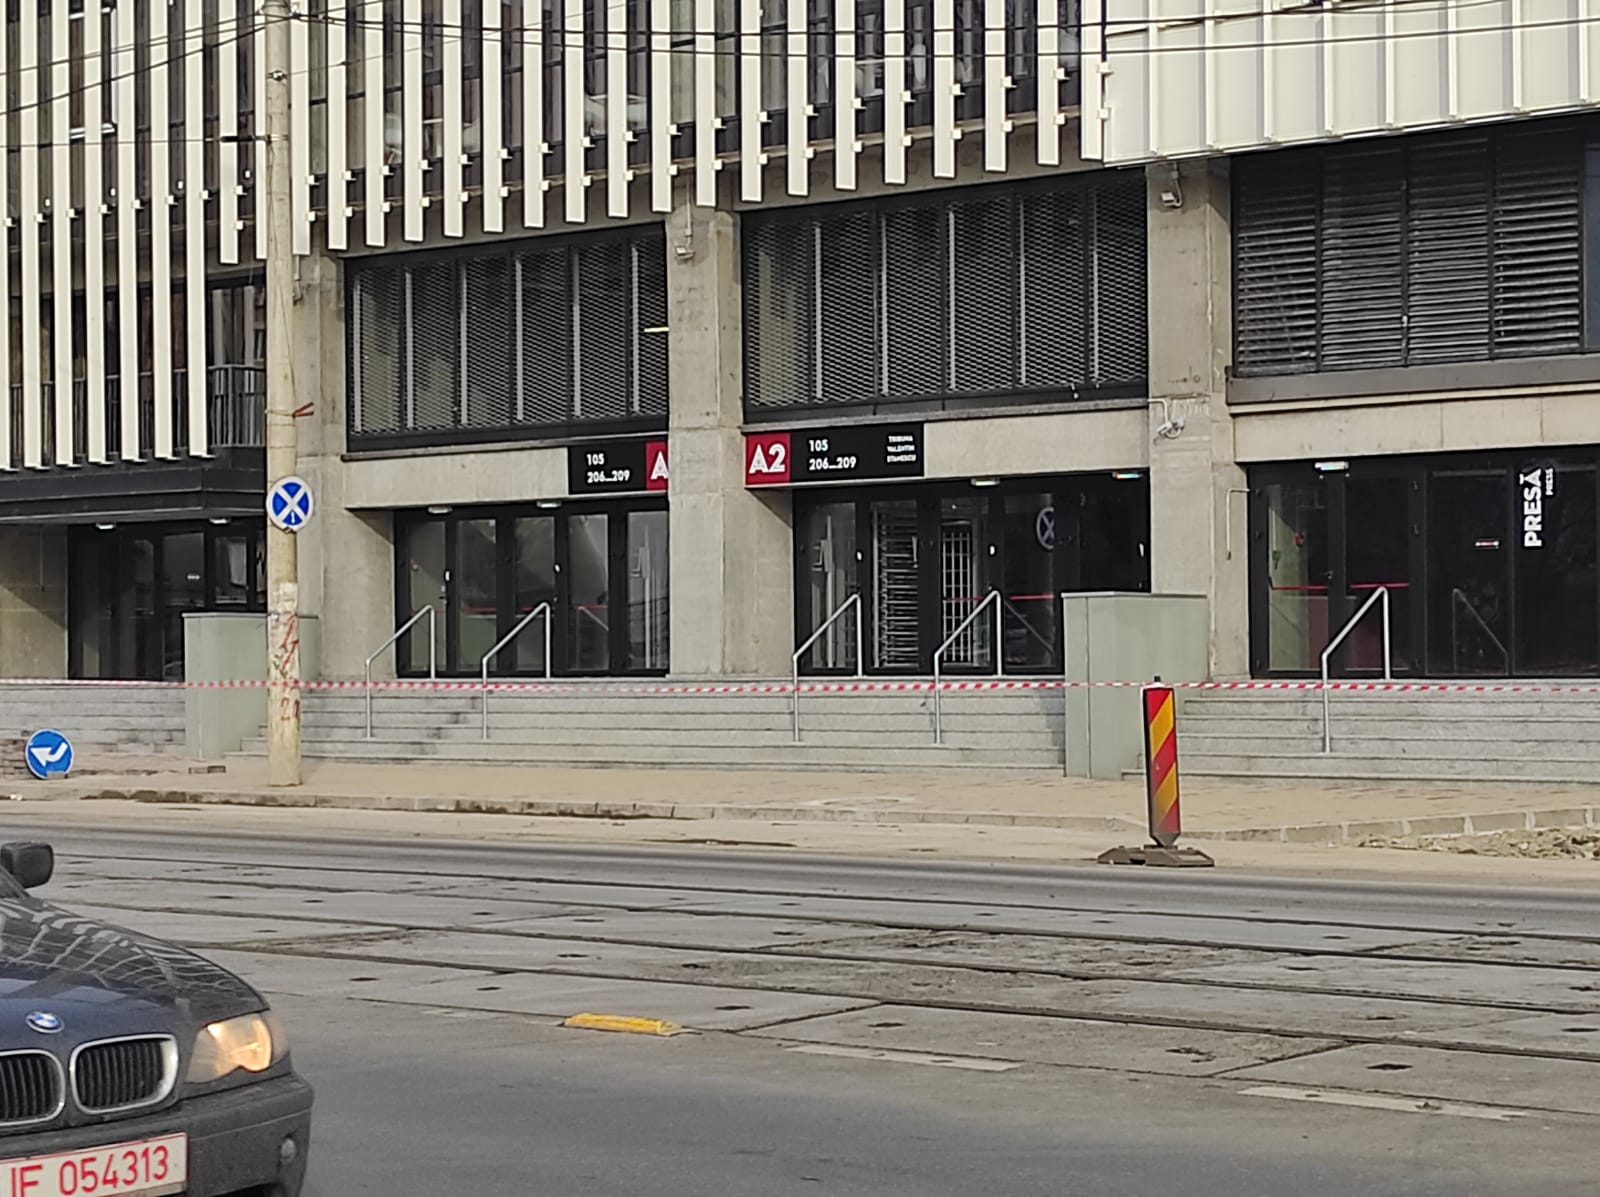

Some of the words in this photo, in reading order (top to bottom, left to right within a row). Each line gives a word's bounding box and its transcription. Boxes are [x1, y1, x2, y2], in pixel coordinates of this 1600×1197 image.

[586, 453, 605, 466] 105
[749, 444, 786, 474] A2
[809, 439, 828, 452] 105
[1519, 468, 1542, 547] PRESĂ
[11, 1164, 43, 1197] IF
[59, 1145, 169, 1196] 054313
